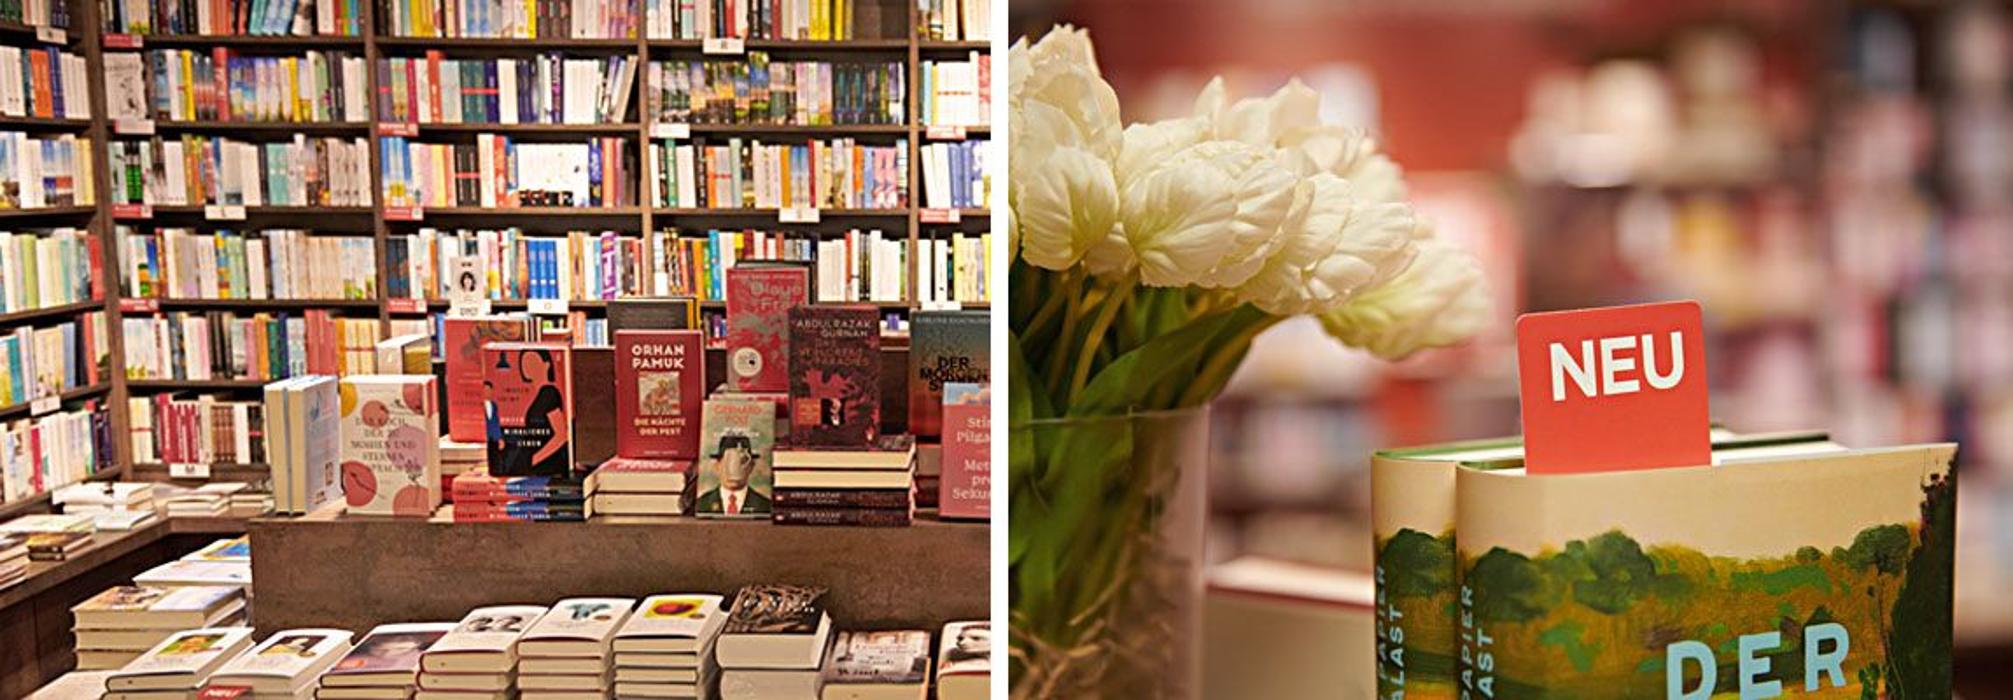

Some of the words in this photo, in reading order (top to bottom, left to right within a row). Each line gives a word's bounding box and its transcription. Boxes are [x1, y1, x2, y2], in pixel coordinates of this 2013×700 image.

[796, 318, 872, 329] ABDULRAZAK
[631, 344, 685, 356] ORHAN
[632, 357, 685, 370] PAMUK
[937, 355, 970, 369] DER
[1550, 330, 1685, 402] NEU
[634, 417, 649, 427] DIE
[651, 416, 686, 427] NÄCHTE
[639, 428, 657, 437] DER
[659, 428, 682, 436] PEST
[1666, 622, 1850, 700] DER
[203, 688, 241, 698] NEU
